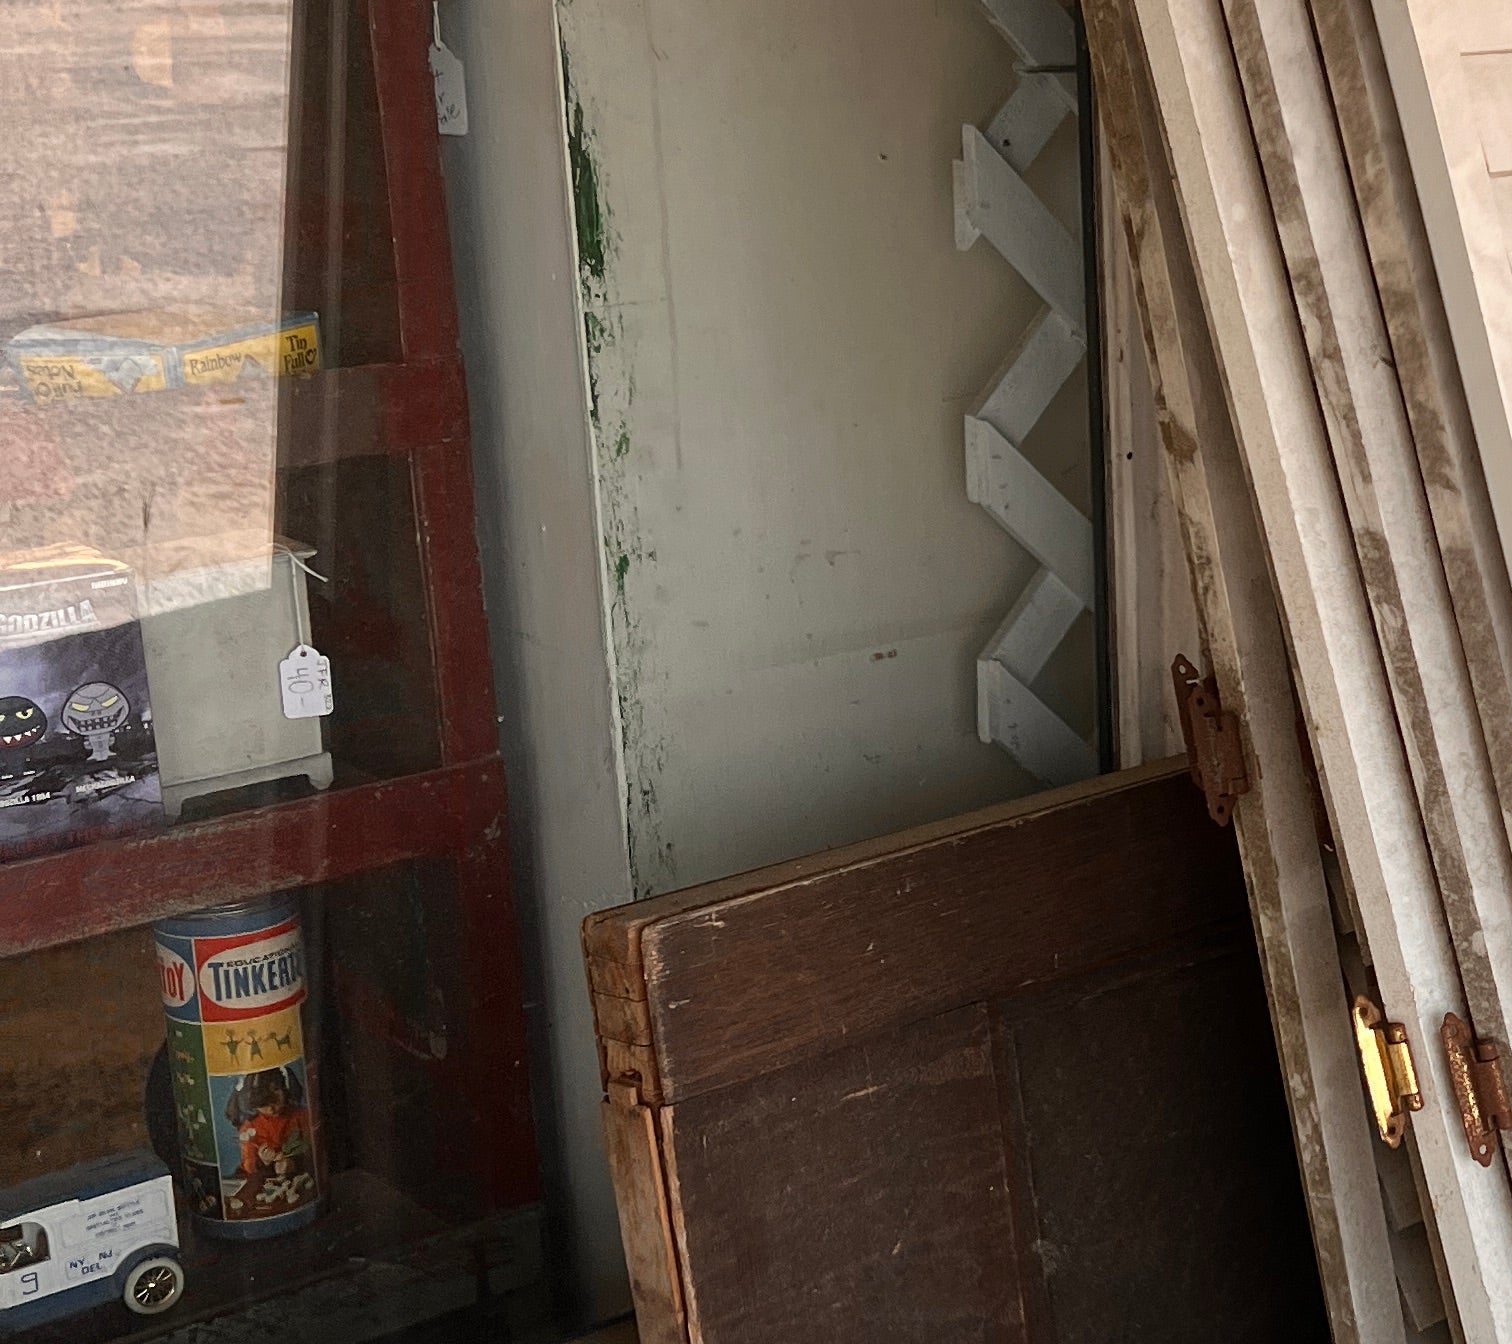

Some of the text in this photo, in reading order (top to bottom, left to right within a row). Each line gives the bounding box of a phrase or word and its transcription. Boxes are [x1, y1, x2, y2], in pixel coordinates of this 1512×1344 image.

[189, 352, 241, 376] Rainbow
[0, 599, 98, 633] GODZILLA
[20, 1271, 39, 1296] 9
